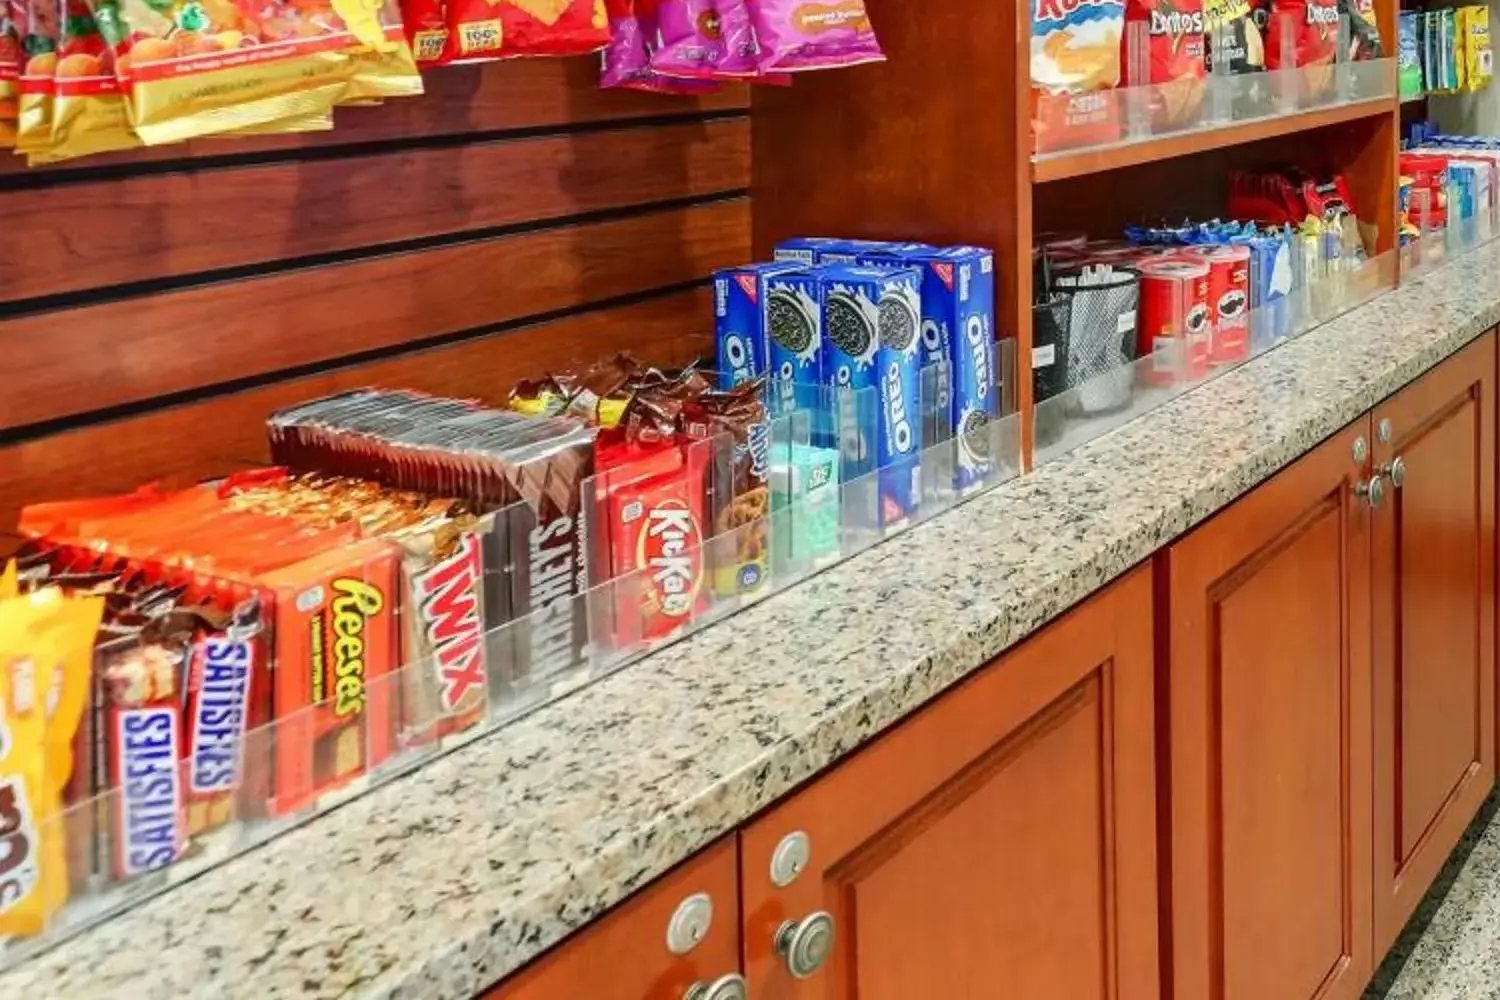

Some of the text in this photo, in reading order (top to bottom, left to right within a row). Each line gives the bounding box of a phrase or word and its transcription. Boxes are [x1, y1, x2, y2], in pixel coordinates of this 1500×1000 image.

[1151, 9, 1203, 34] Doritos
[888, 361, 912, 454] OREO
[967, 314, 988, 401] OREO
[422, 532, 485, 710] TWIX
[192, 641, 254, 790] SATISFIES
[124, 710, 177, 870] SATISFIES
